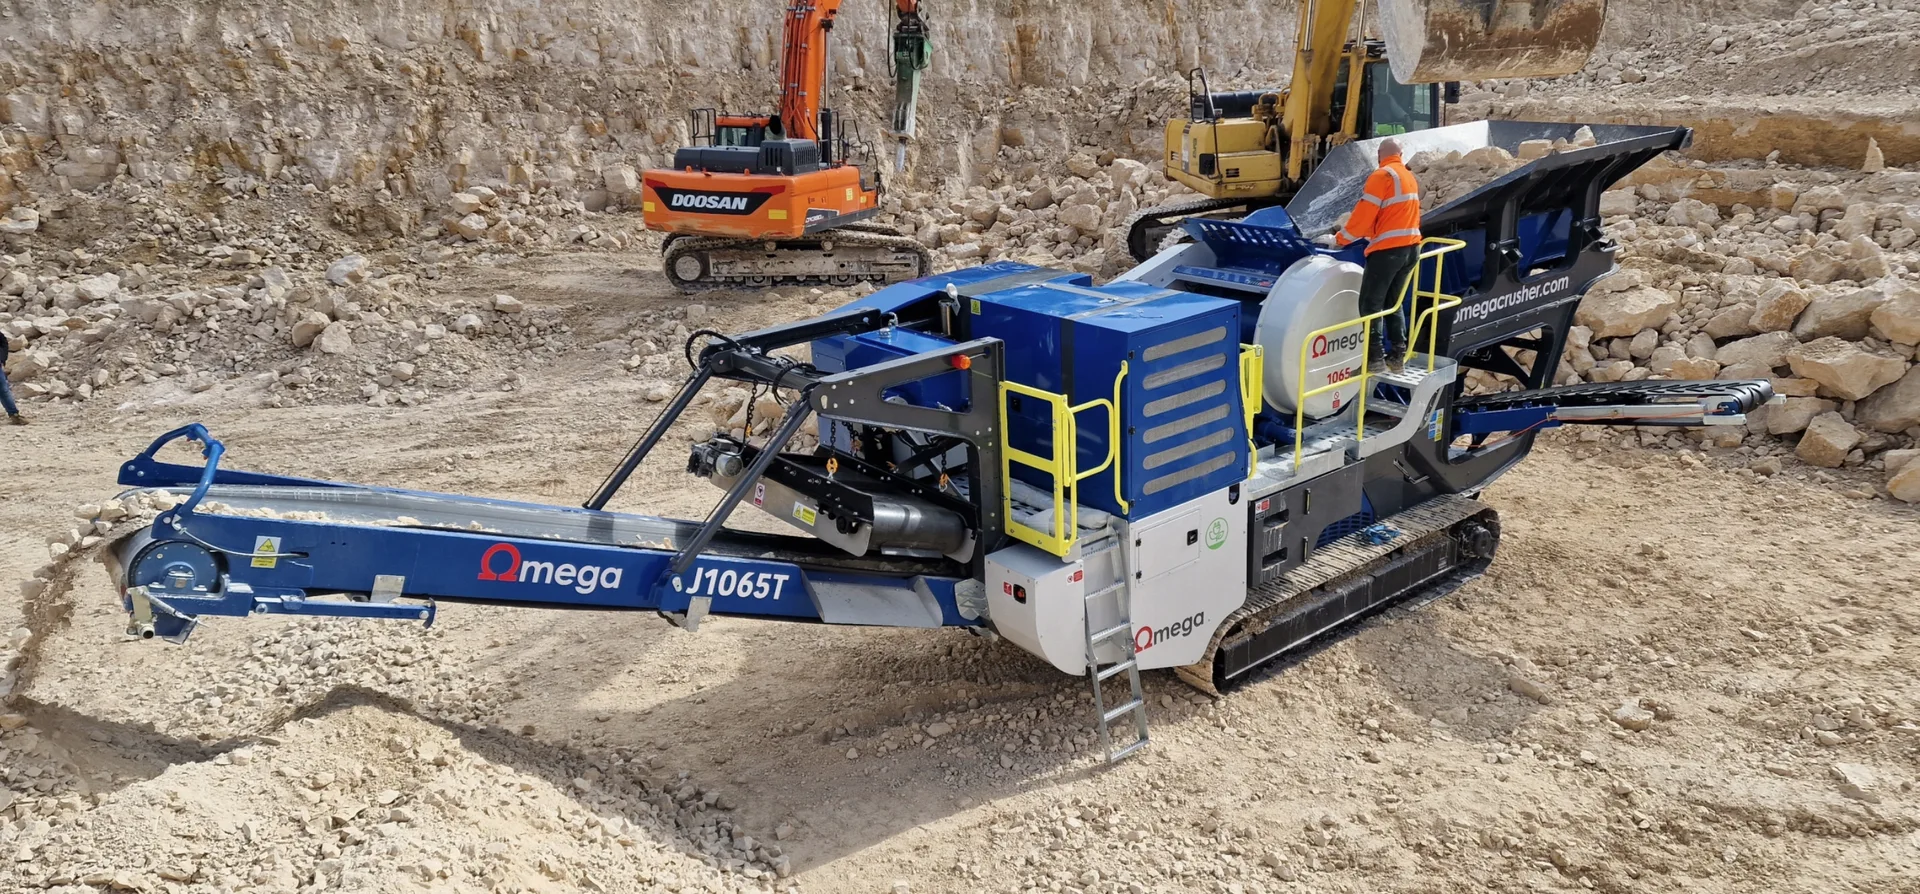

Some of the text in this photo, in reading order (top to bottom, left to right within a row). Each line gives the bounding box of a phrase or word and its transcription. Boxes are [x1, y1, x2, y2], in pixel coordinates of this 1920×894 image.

[671, 193, 748, 211] DOOSAN
[1326, 366, 1352, 385] 1065
[685, 567, 790, 600] J1065T
